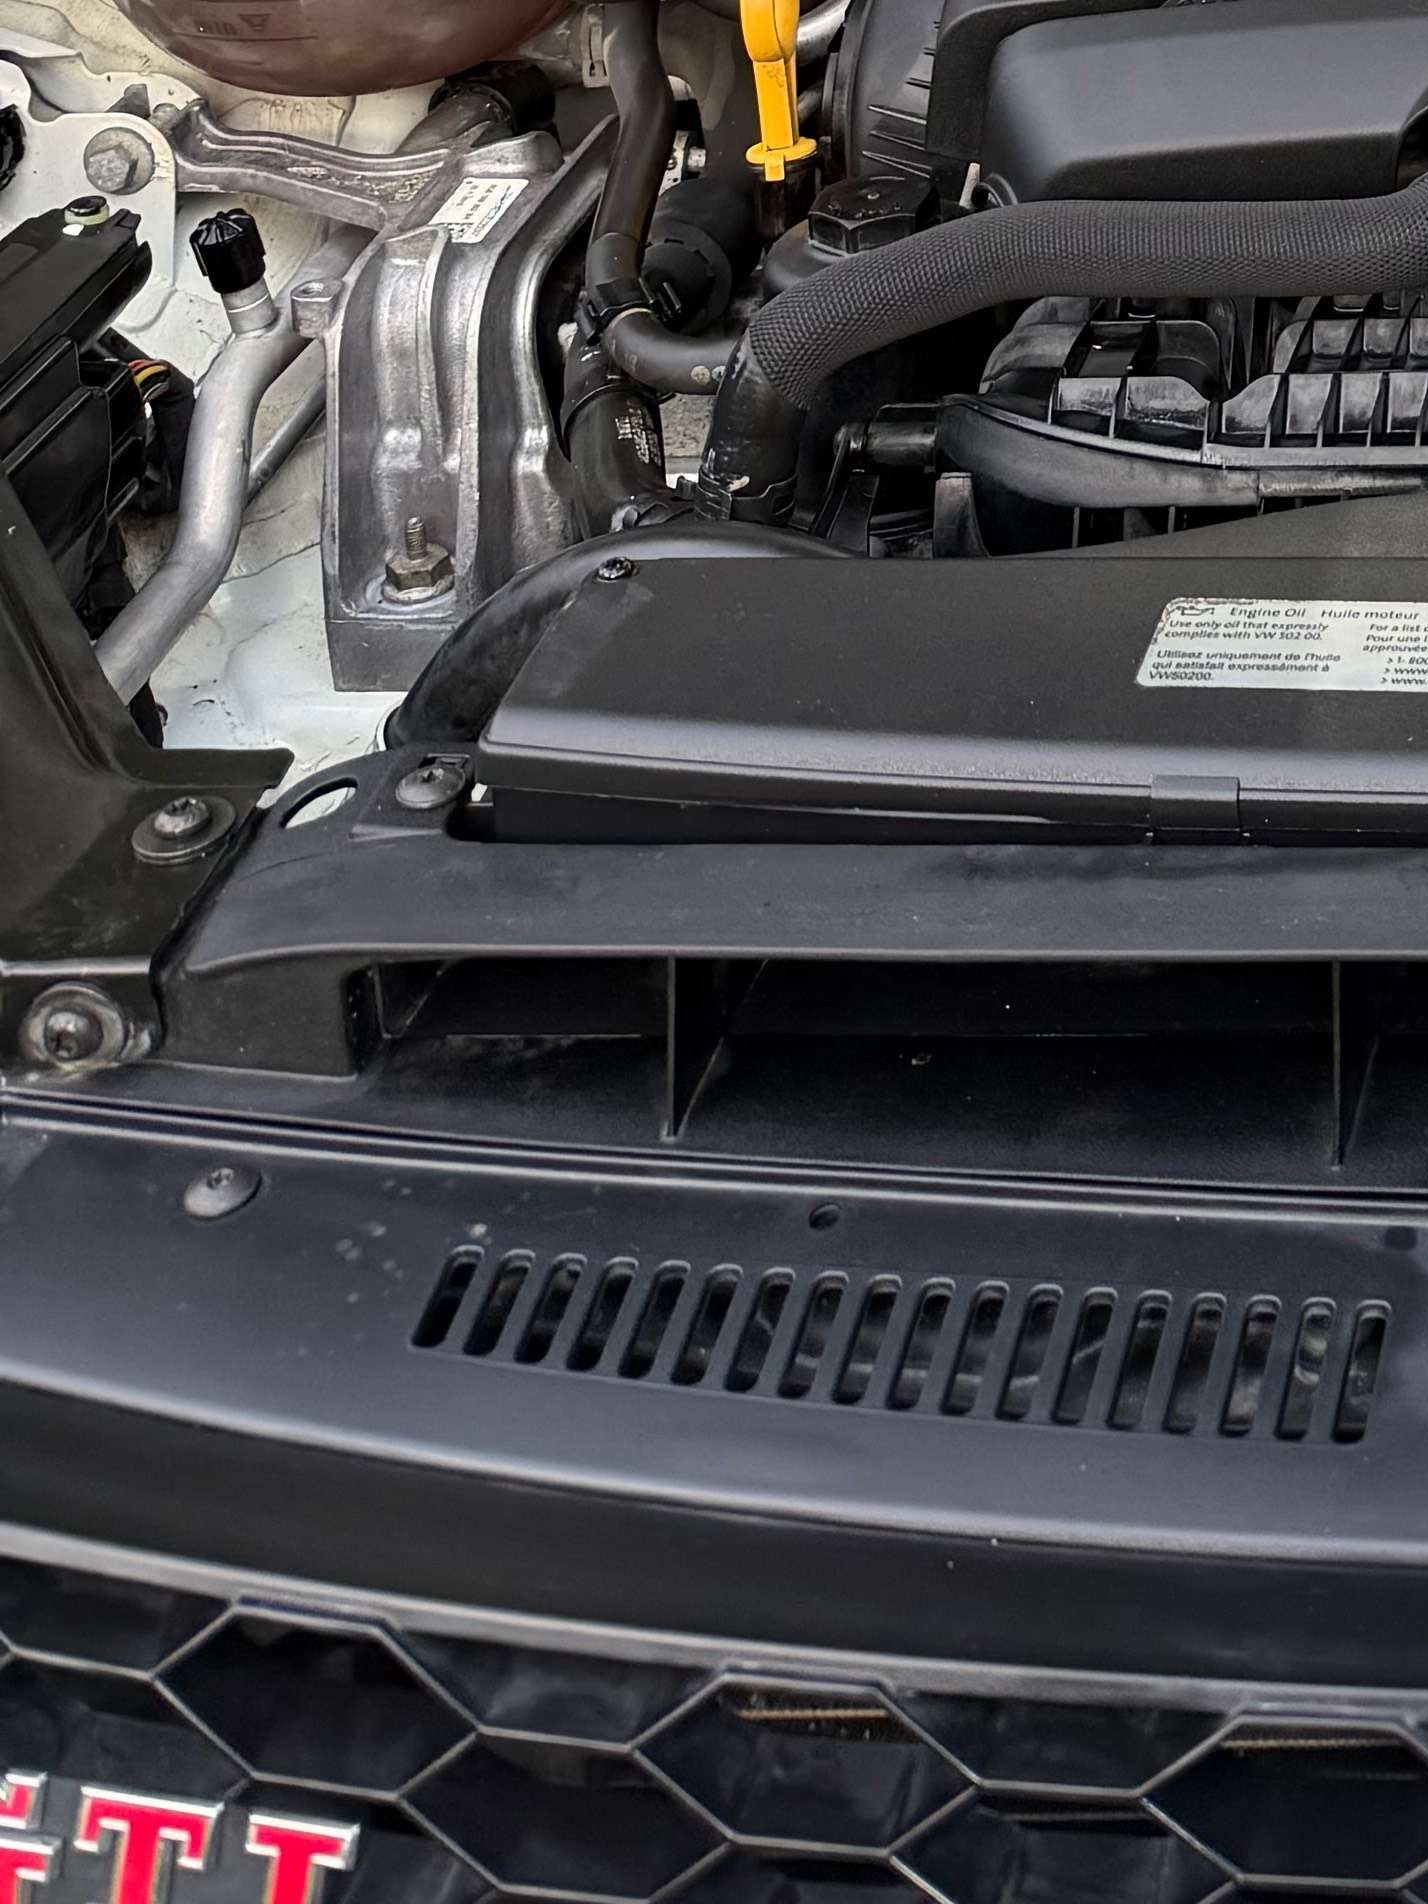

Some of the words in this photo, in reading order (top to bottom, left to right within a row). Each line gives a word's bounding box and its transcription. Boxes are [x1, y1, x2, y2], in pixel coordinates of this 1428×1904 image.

[1230, 607, 1280, 620] Engine
[1285, 608, 1306, 617] Oil
[1321, 609, 1360, 619] Huile
[1364, 611, 1420, 620] moteur
[1169, 620, 1192, 628] Use
[1195, 621, 1221, 630] only
[1224, 621, 1239, 629] oil
[1271, 622, 1328, 632] expressly
[1370, 624, 1388, 632] For
[1402, 624, 1421, 633] list
[1165, 631, 1219, 640] complies
[1223, 631, 1250, 639] with
[1255, 632, 1276, 640] VW
[1366, 635, 1396, 643] Pour
[1207, 651, 1281, 661] uniquement
[1285, 653, 1300, 661] de
[1152, 661, 1171, 670] qui
